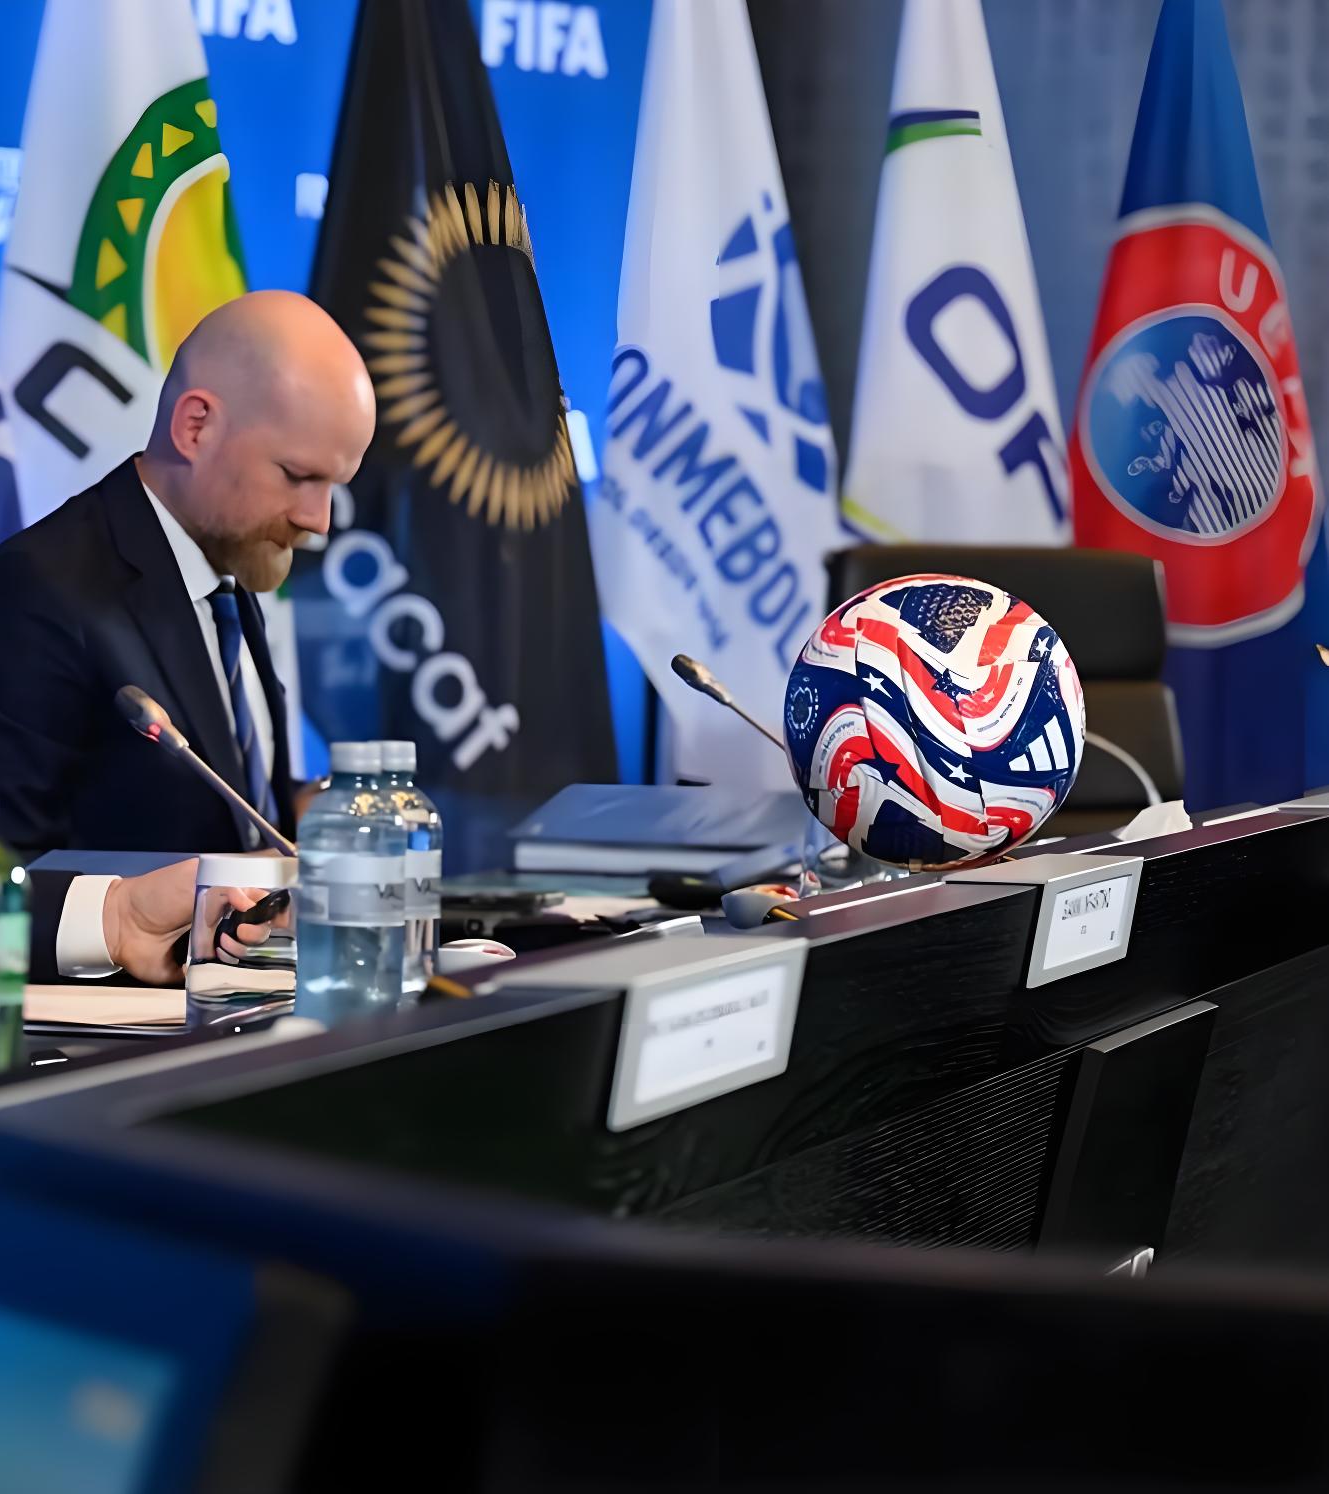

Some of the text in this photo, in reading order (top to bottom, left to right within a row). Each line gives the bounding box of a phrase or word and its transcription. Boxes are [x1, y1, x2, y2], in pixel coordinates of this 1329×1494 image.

[194, 0, 299, 45] IFA
[480, 0, 609, 79] FIFA
[607, 347, 813, 678] ONMEBOL
